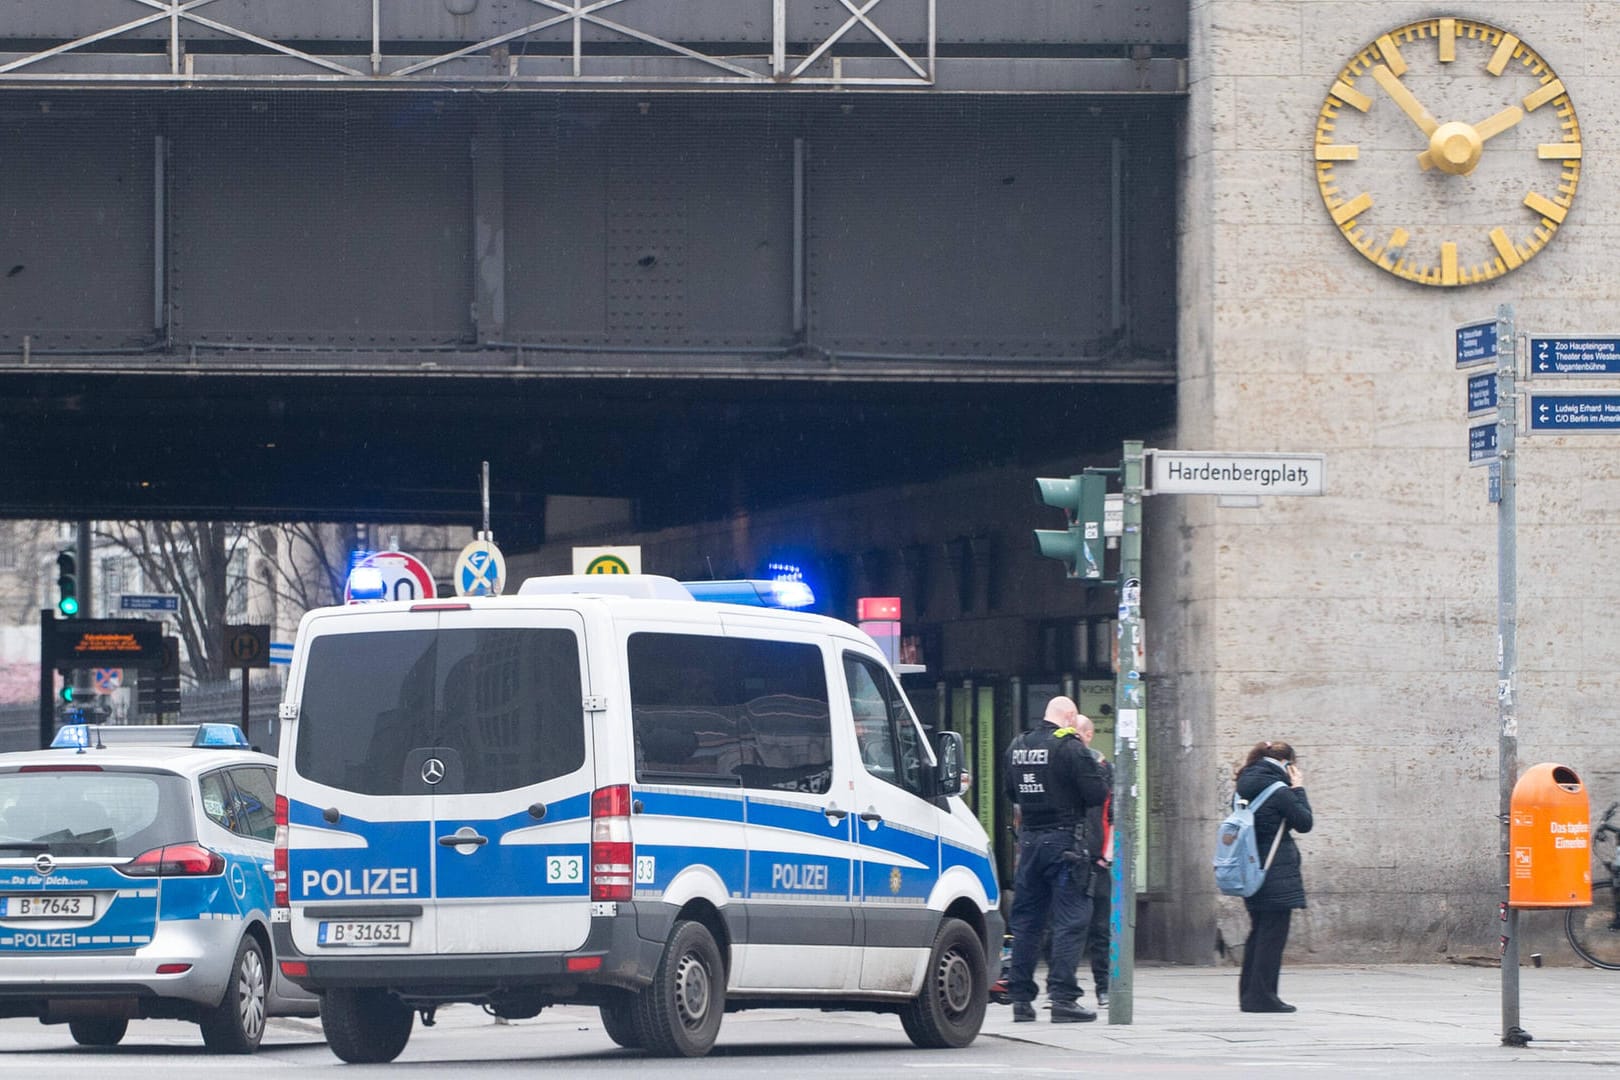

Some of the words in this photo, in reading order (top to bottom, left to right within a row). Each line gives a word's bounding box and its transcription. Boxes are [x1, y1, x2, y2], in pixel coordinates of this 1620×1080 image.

[1555, 342, 1568, 350] Zoo
[1570, 341, 1615, 351] Haupteingang
[1555, 352, 1580, 360] Theater
[1581, 352, 1594, 360] des
[1555, 362, 1606, 372] Vagantenbühne
[1555, 404, 1578, 414] Ludwig
[1580, 404, 1602, 412] Erhard
[1169, 462, 1309, 486] Hardenbergplatz
[1012, 749, 1049, 765] POLIZEI
[1023, 773, 1037, 783] BE
[1551, 822, 1566, 834] Das
[27, 876, 42, 885] für
[302, 867, 418, 897] POLIZEI
[772, 863, 828, 889] POLIZEI
[21, 899, 30, 914] B
[42, 898, 80, 914] 7643
[335, 924, 345, 941] B
[354, 924, 401, 940] 31631
[14, 932, 76, 947] POLIZEI
